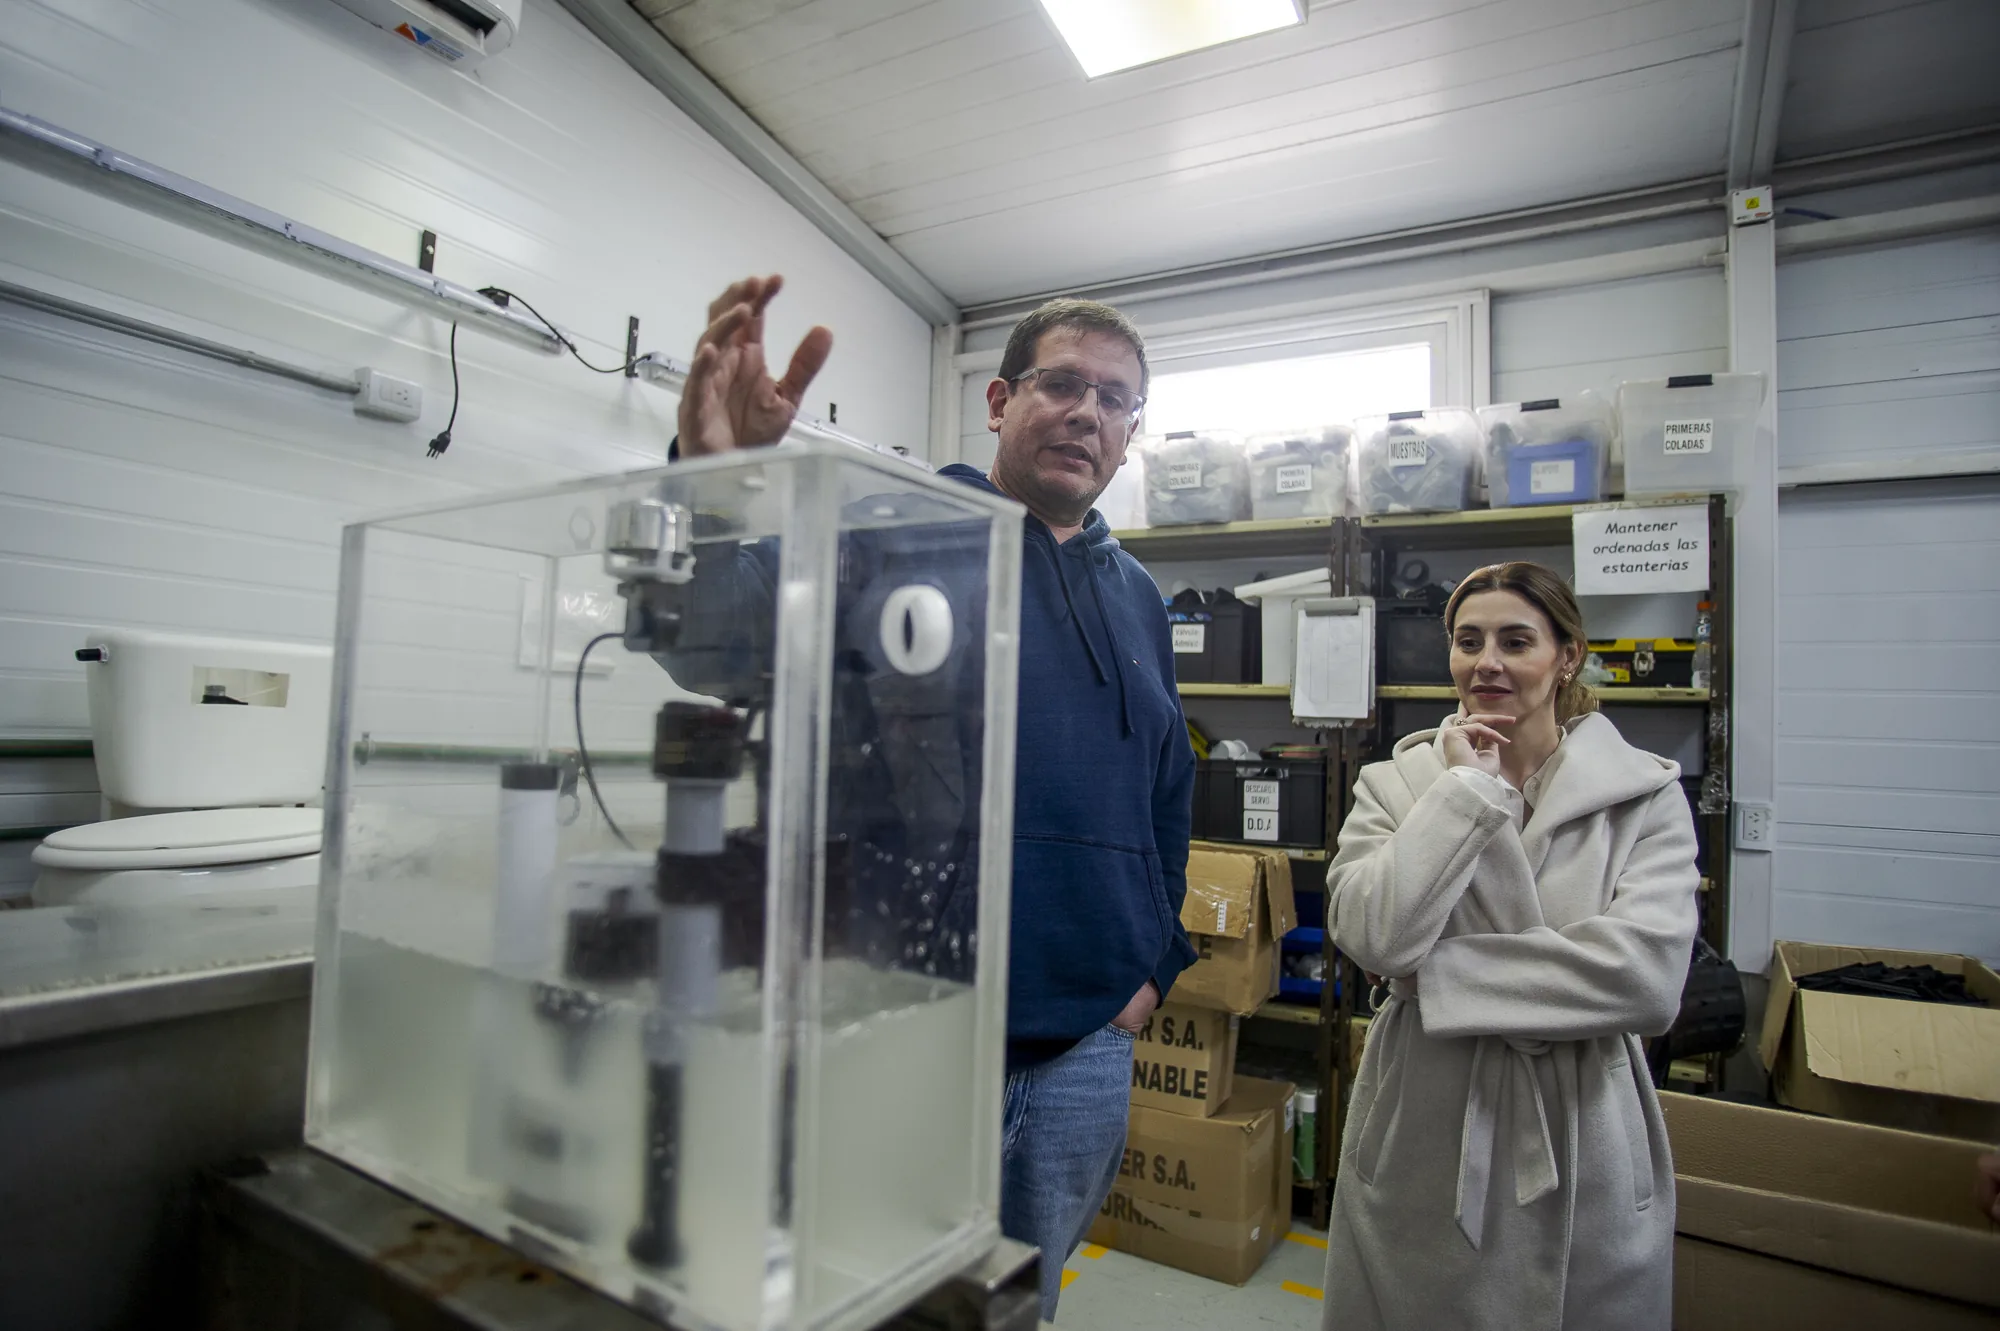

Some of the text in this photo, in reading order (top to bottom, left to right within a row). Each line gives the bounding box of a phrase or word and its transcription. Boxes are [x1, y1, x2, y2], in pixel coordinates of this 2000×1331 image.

[1665, 423, 1712, 434] PRIMERAS
[1390, 440, 1426, 459] MUESTRAS
[1665, 439, 1705, 450] COLADAS
[1280, 479, 1306, 489] COLADAS
[1605, 521, 1678, 534] Mantener
[1593, 538, 1699, 554] ordenadas las
[1602, 559, 1690, 574] estanterias
[1250, 796, 1270, 805] SERVO
[1160, 1016, 1204, 1050] S.A.
[1132, 1058, 1209, 1100] NABLE
[1152, 1154, 1197, 1191] S.A.
